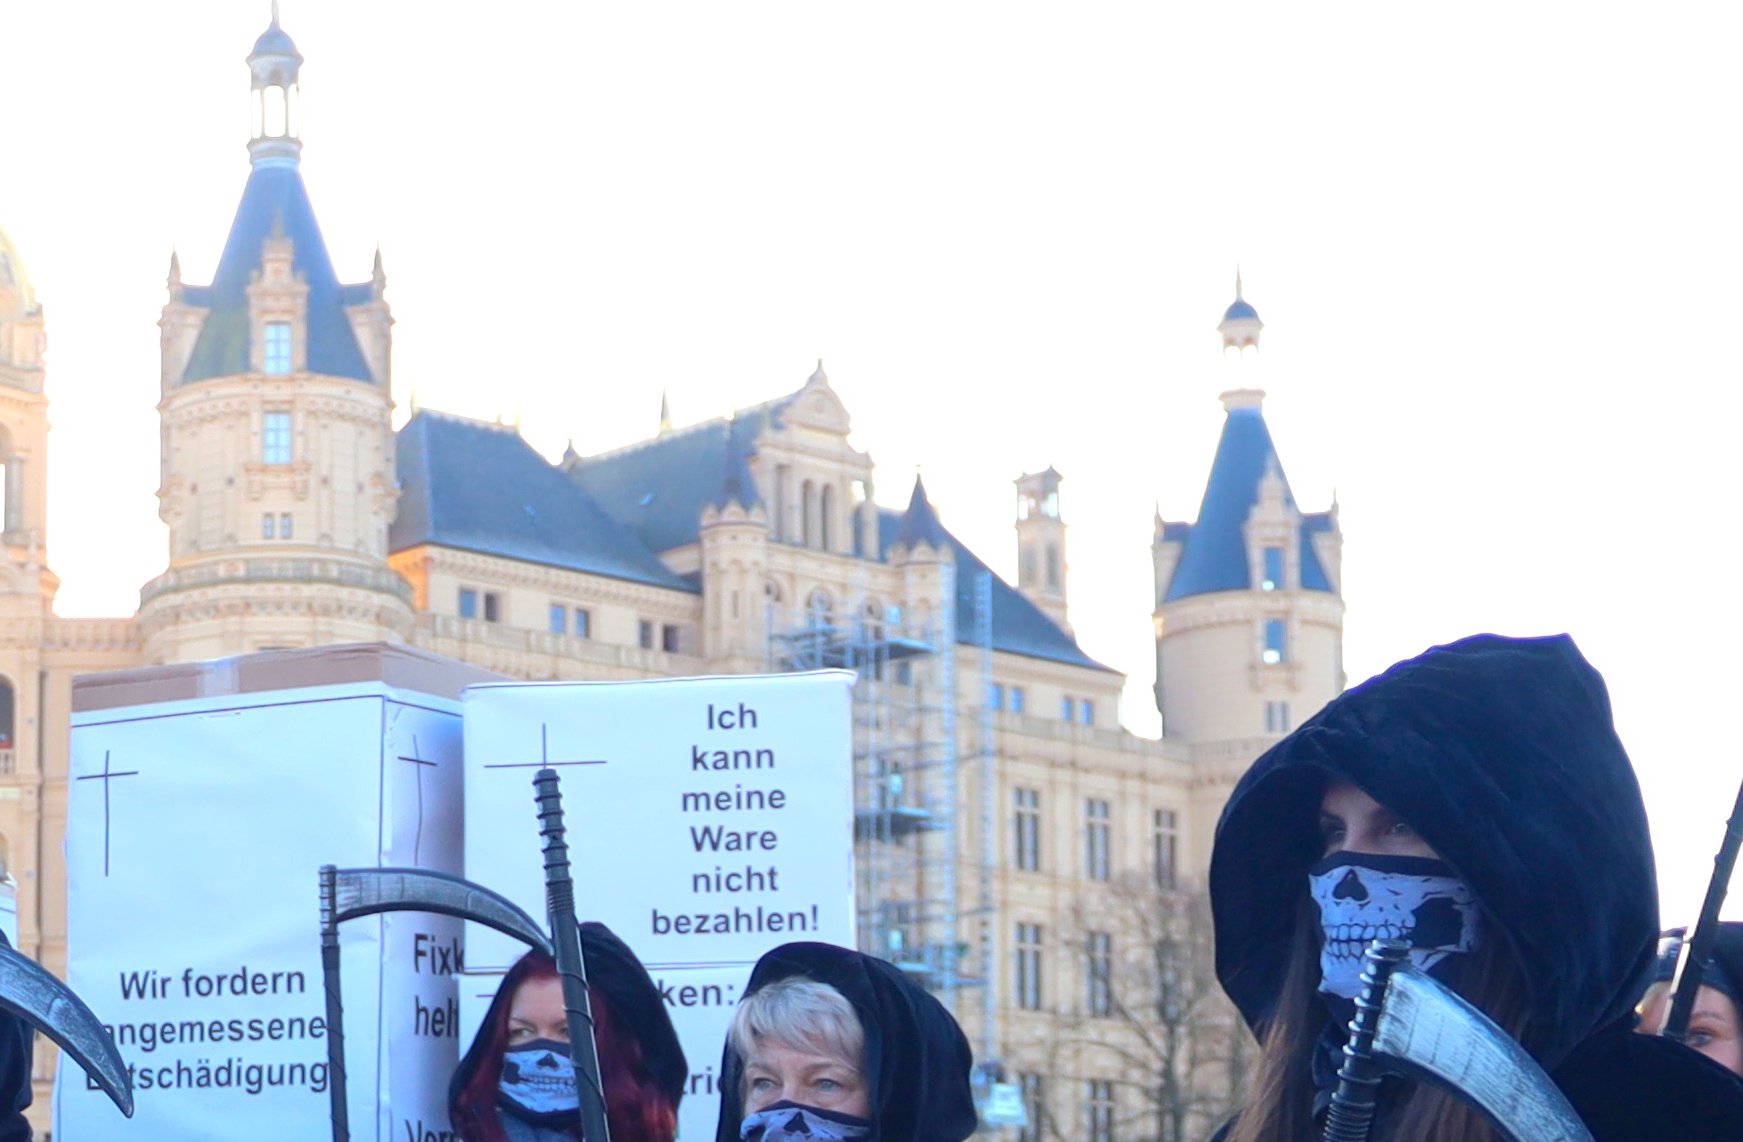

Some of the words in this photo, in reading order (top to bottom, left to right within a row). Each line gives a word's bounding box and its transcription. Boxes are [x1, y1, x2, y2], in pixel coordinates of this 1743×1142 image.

[708, 702, 758, 730] Ich
[691, 745, 775, 771] kann
[681, 784, 787, 812] meine
[689, 825, 779, 852] Ware
[692, 865, 779, 893] nicht
[651, 904, 819, 935] bezahlen!
[119, 969, 172, 1001] Wir
[182, 966, 306, 998] fordern
